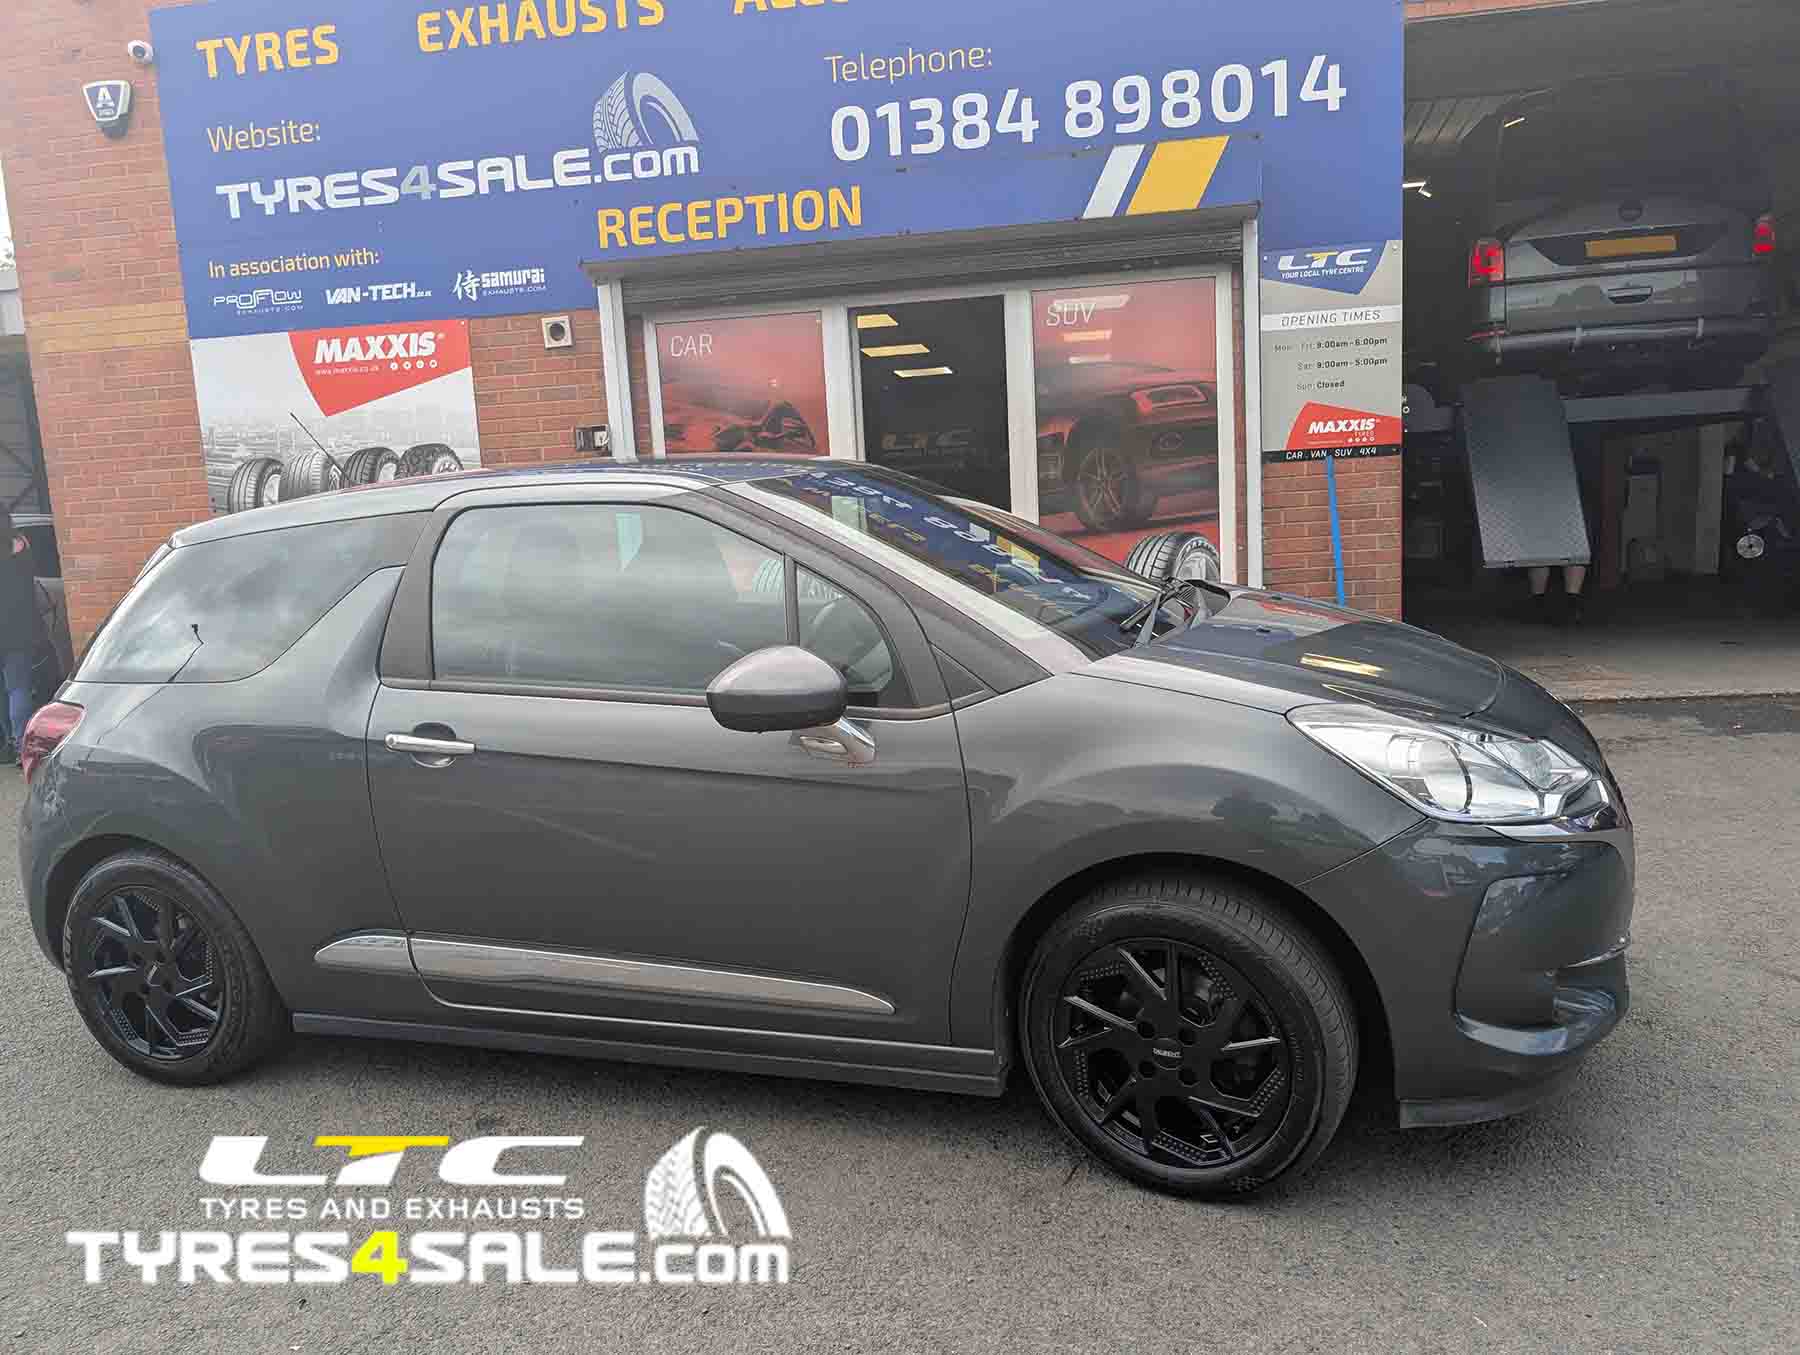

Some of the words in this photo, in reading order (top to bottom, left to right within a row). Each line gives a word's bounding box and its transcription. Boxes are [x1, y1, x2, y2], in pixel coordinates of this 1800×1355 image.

[416, 0, 665, 53] EXHAUSTS
[196, 25, 340, 78] TYRES
[824, 46, 993, 84] Telephone:
[830, 88, 1040, 161] 01384
[1063, 54, 1348, 138] 898014
[207, 120, 321, 153] Website:
[215, 145, 700, 219] TYRES4SALE.com
[597, 185, 863, 249] RECEPTION
[208, 260, 225, 278] In
[230, 253, 331, 276] association
[334, 248, 380, 267] with:
[1278, 247, 1372, 271] LTC
[1281, 272, 1299, 280] YOUR
[1300, 270, 1320, 279] LOCAL
[1046, 302, 1097, 326] SUV
[1280, 312, 1338, 327] OPENING
[1343, 309, 1382, 321] TIMES
[313, 331, 437, 364] MAXXIS
[669, 333, 714, 359] CAR
[1316, 380, 1345, 389] Closed
[1309, 419, 1375, 433] MAXXIS
[1285, 451, 1303, 460] CAR
[1310, 450, 1328, 459] VAN
[1334, 448, 1353, 457] SUV
